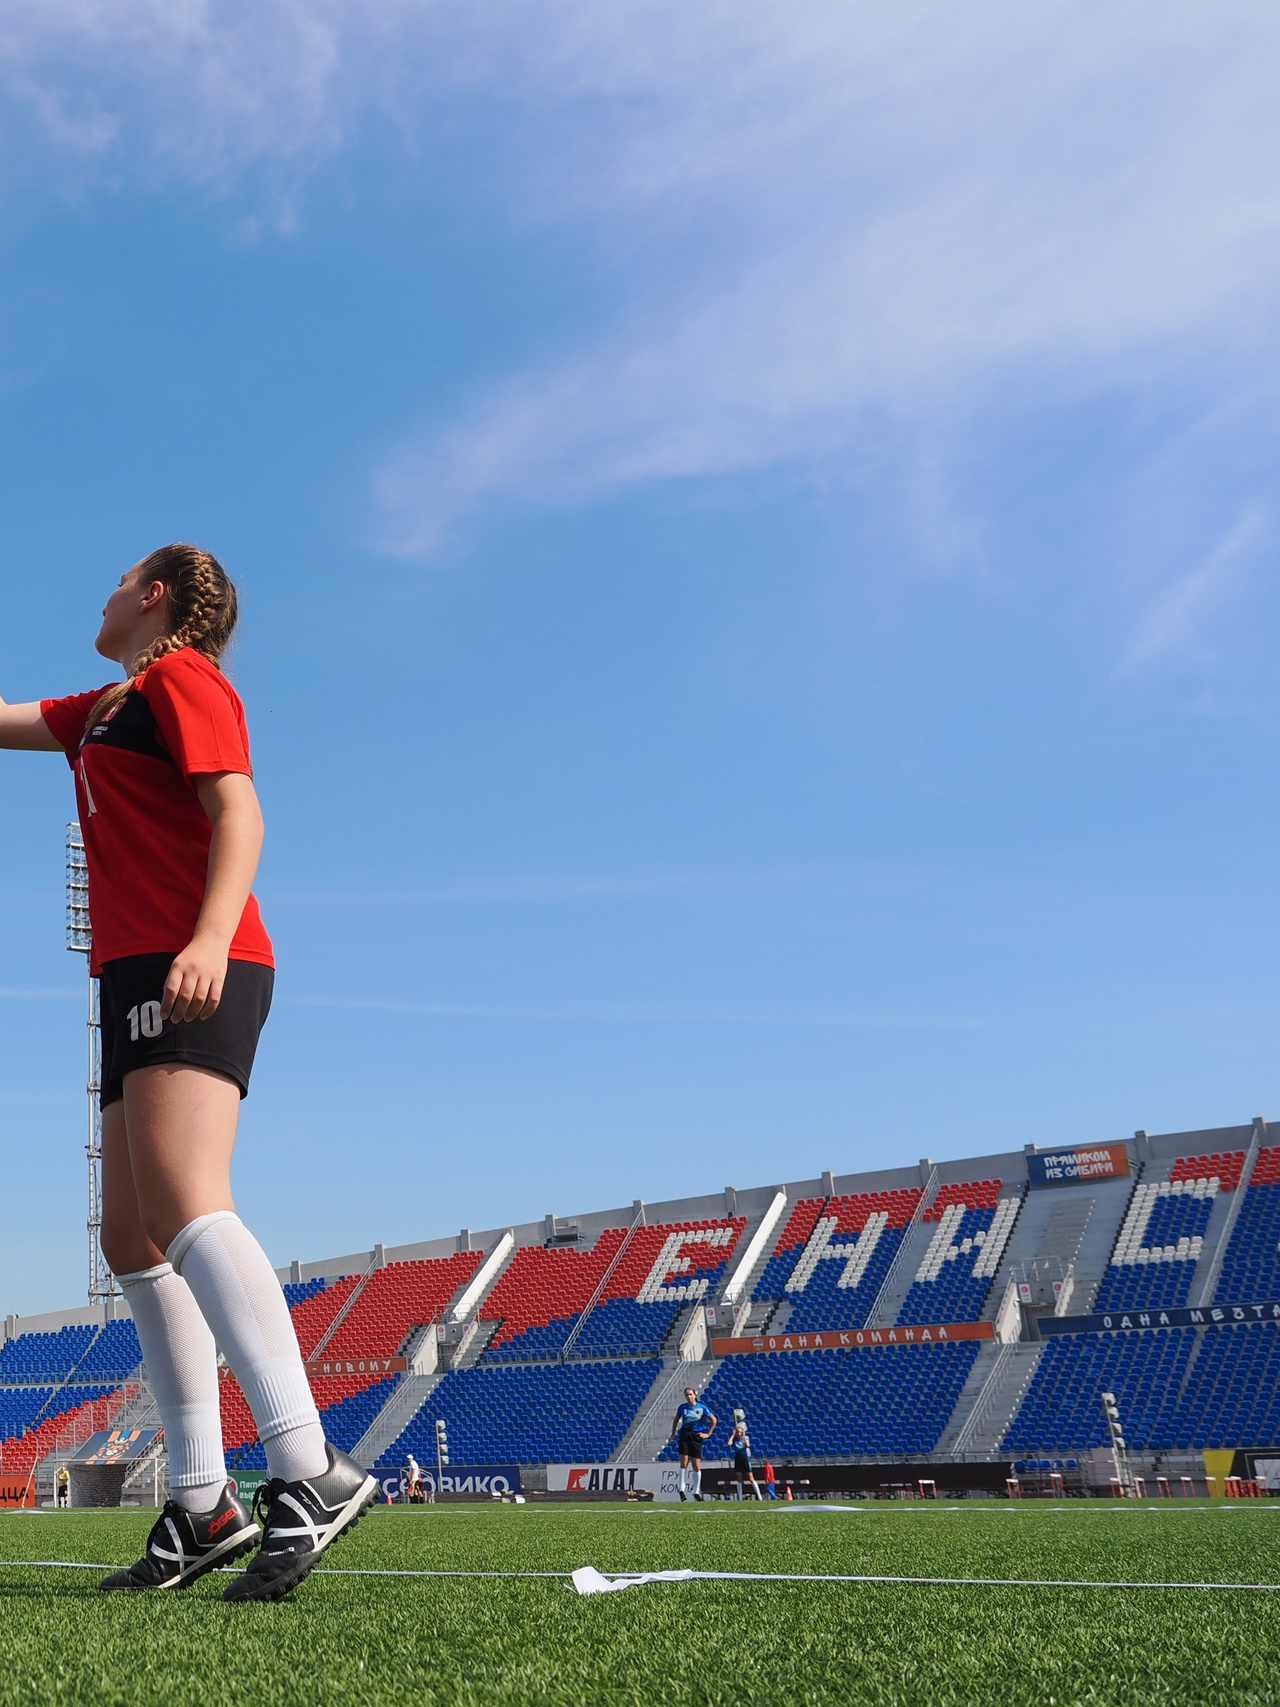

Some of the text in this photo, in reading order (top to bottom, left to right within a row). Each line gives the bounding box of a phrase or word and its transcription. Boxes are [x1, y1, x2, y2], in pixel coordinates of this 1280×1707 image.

[126, 1000, 163, 1042] 10
[1043, 1150, 1111, 1168] ПРЯМИКОМ
[1045, 1162, 1114, 1180] ИЗ СИБИРИ
[769, 1326, 948, 1350] ОДНА КОМАНДА
[303, 1360, 391, 1374] -НОВОМУ
[588, 1468, 638, 1491] АГАТ
